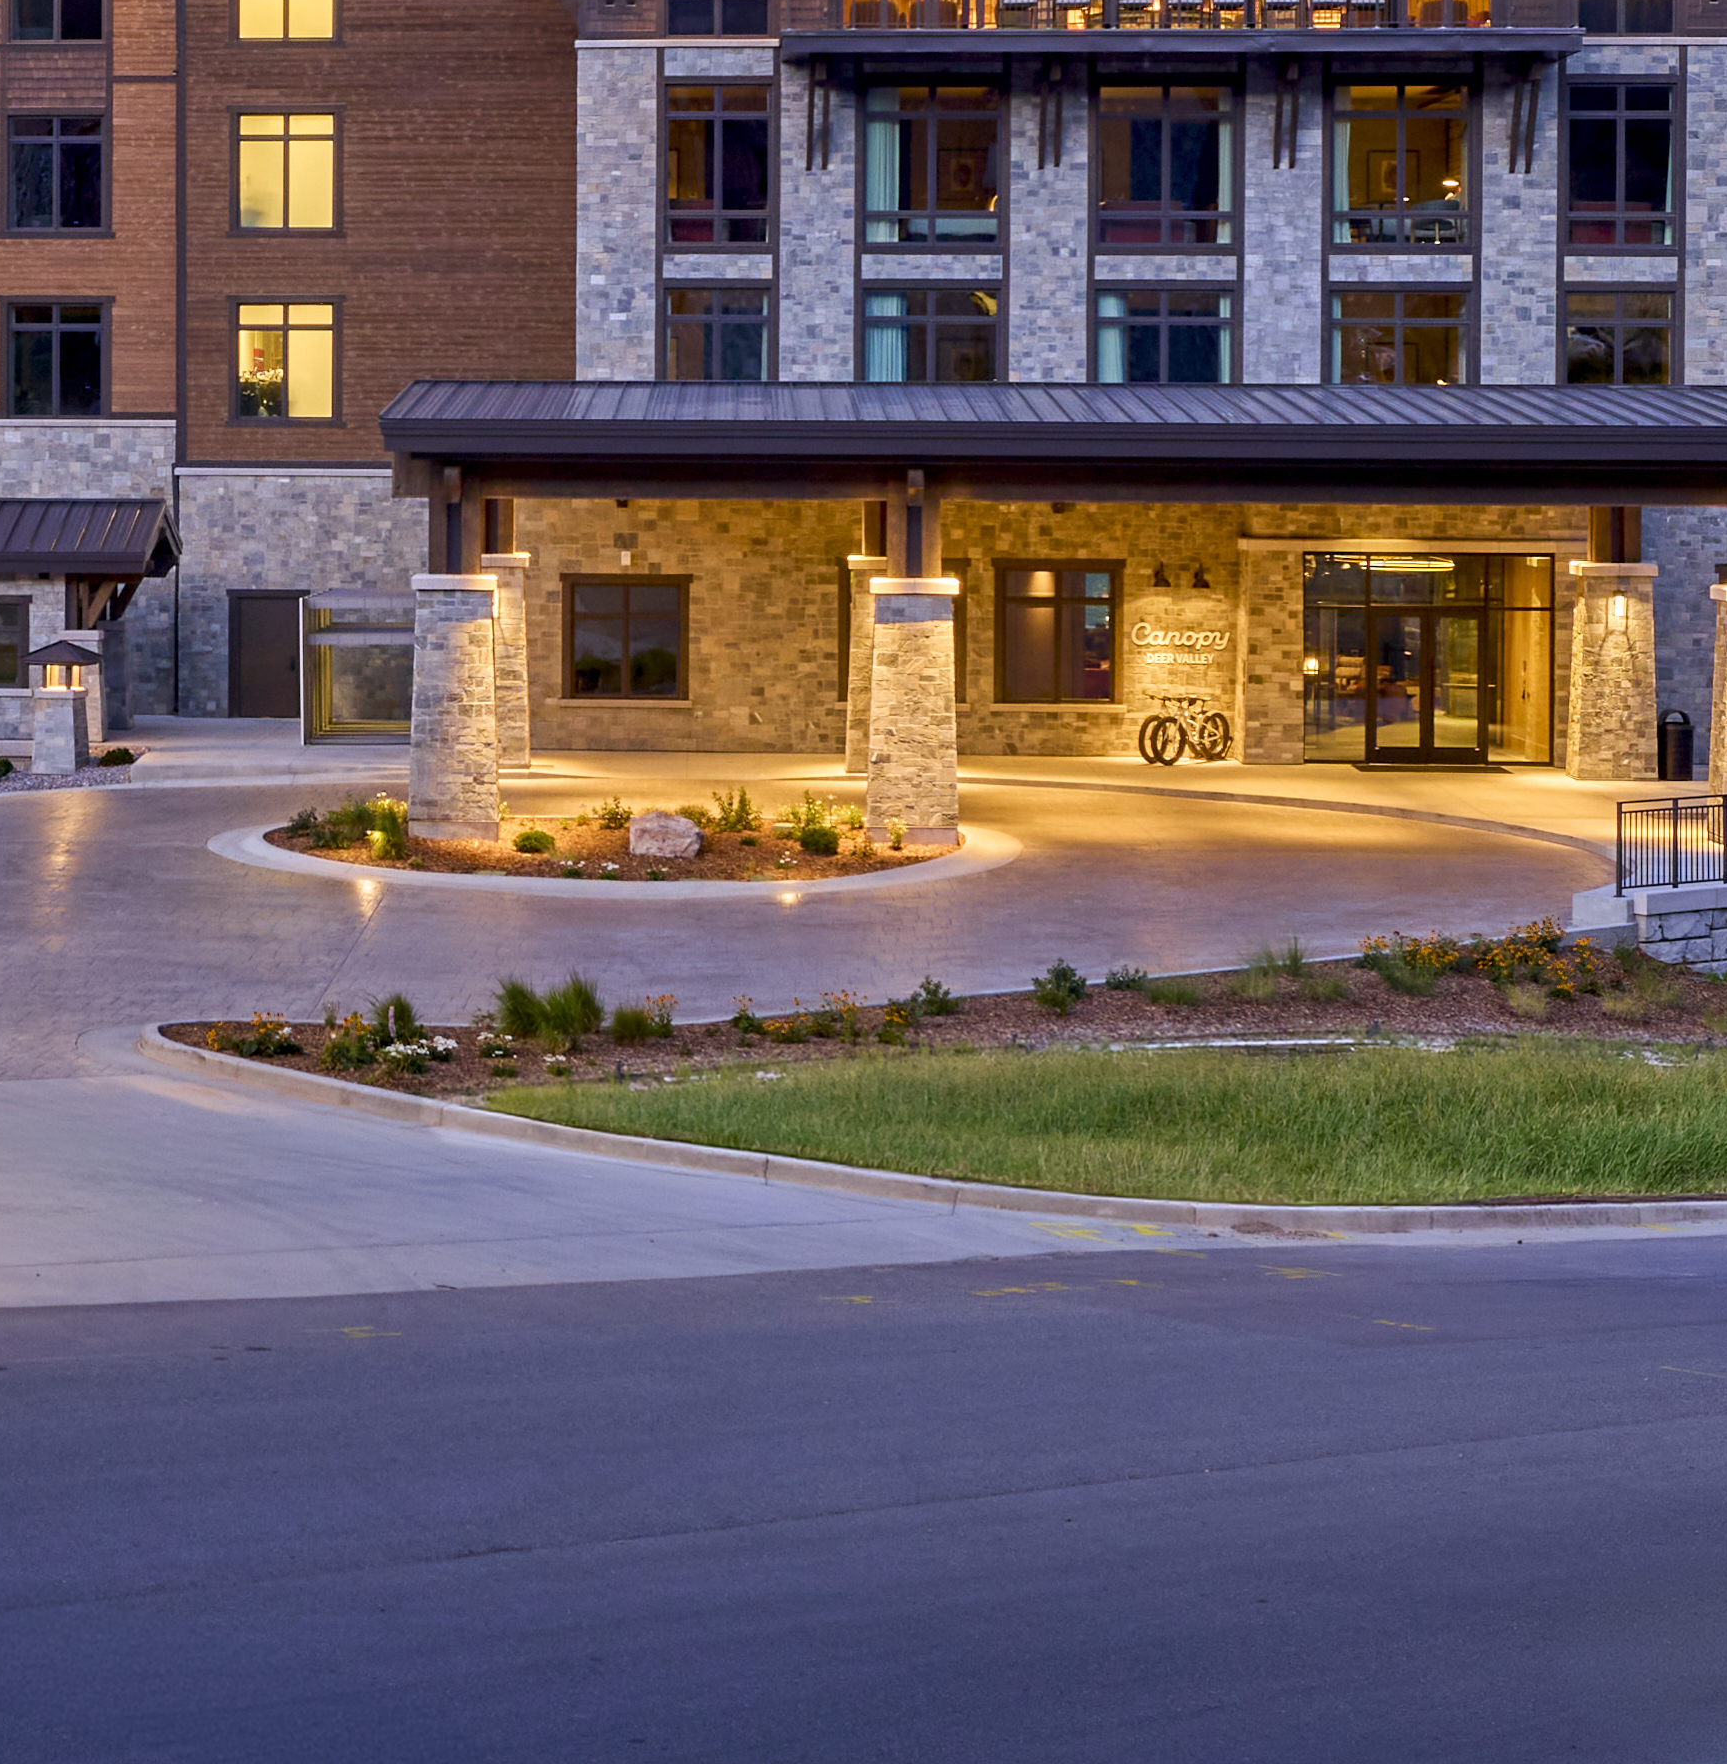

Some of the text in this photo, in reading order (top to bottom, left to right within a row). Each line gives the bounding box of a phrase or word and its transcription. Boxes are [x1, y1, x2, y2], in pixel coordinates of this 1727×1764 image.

[1131, 622, 1231, 651] Canopy
[1147, 653, 1214, 664] DEER VALLEY
